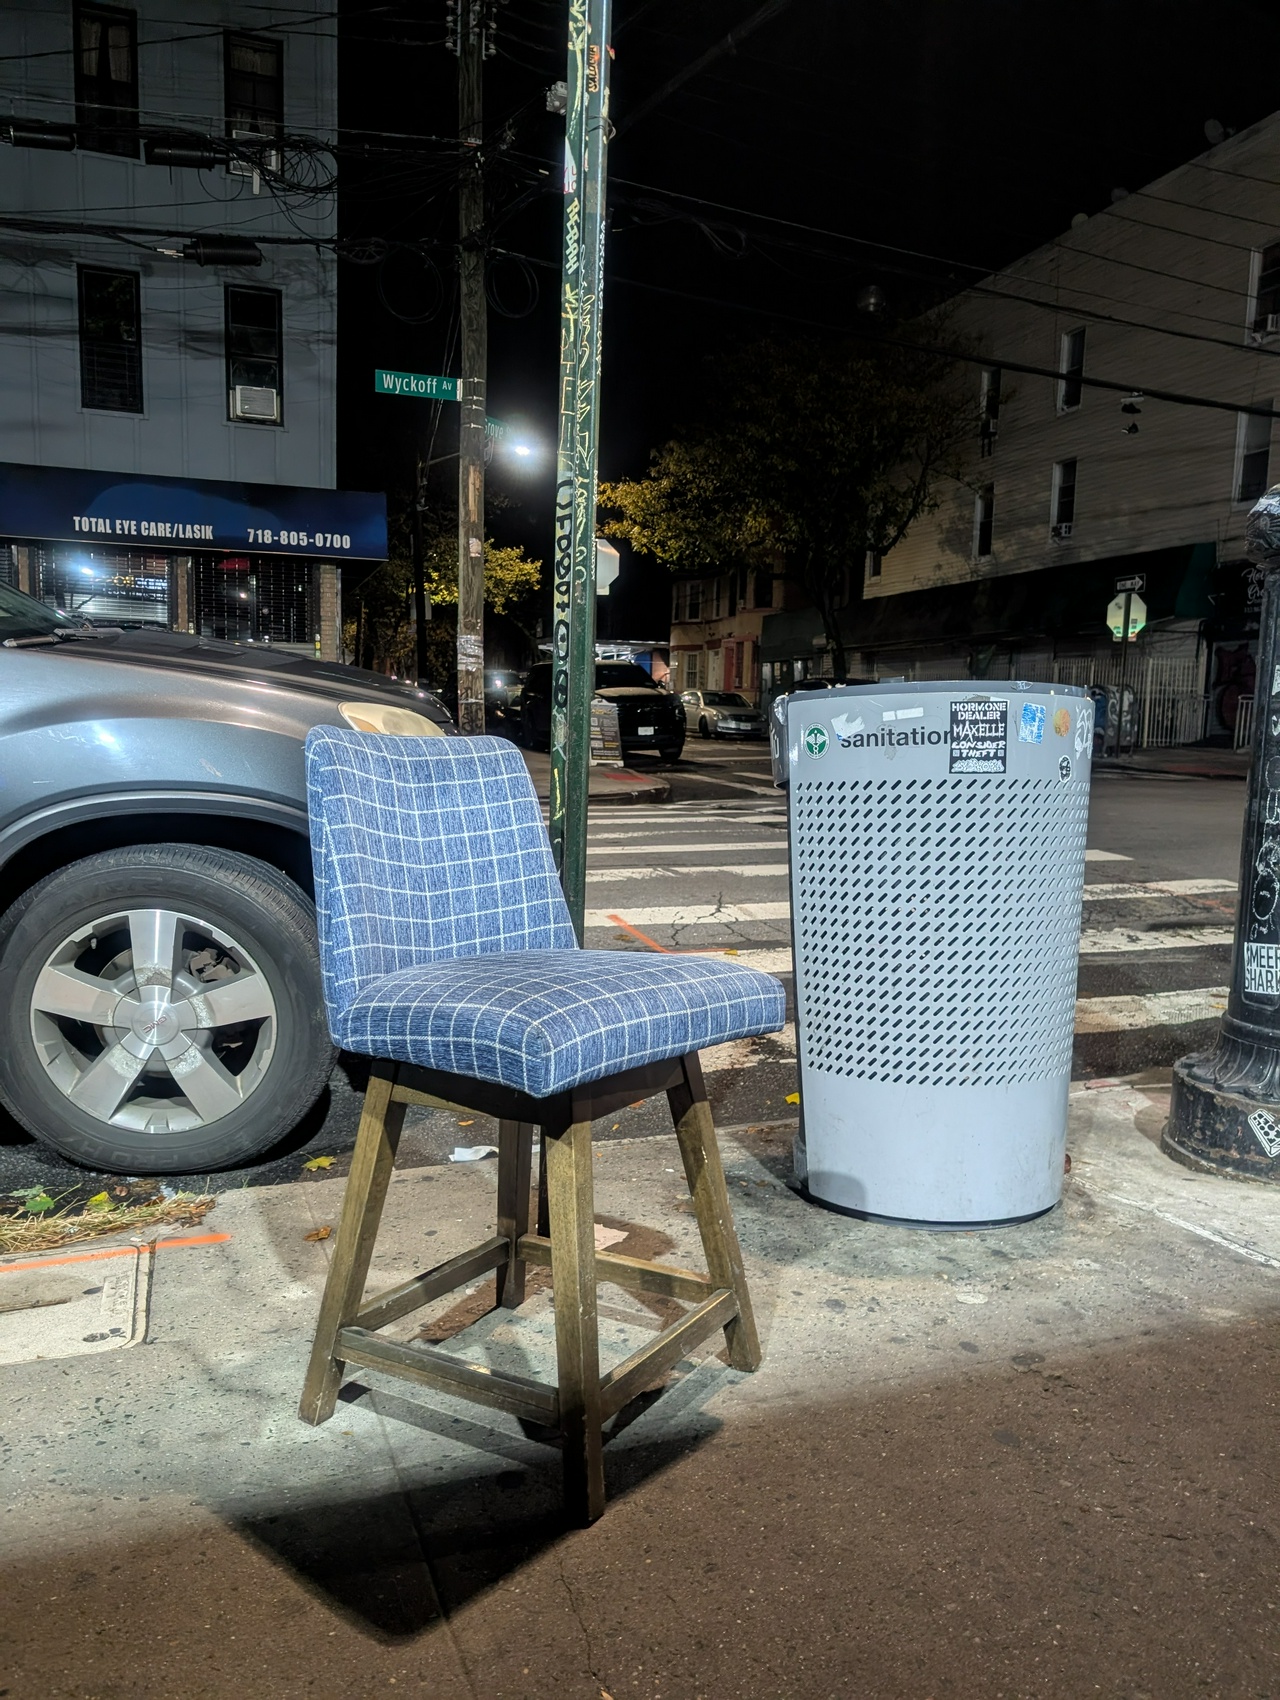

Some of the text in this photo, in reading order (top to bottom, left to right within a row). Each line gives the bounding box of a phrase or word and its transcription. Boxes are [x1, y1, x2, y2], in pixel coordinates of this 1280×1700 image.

[382, 373, 452, 394] Wyckoff Av
[73, 516, 213, 540] TOTAL EYE CARE/LASIK
[247, 528, 351, 549] 718-805-0700
[951, 702, 1007, 712] HORMONE
[958, 711, 1001, 720] DEALER
[952, 720, 1006, 743] MAXELLE
[961, 749, 997, 758] THEFT
[142, 1016, 168, 1034] GMC
